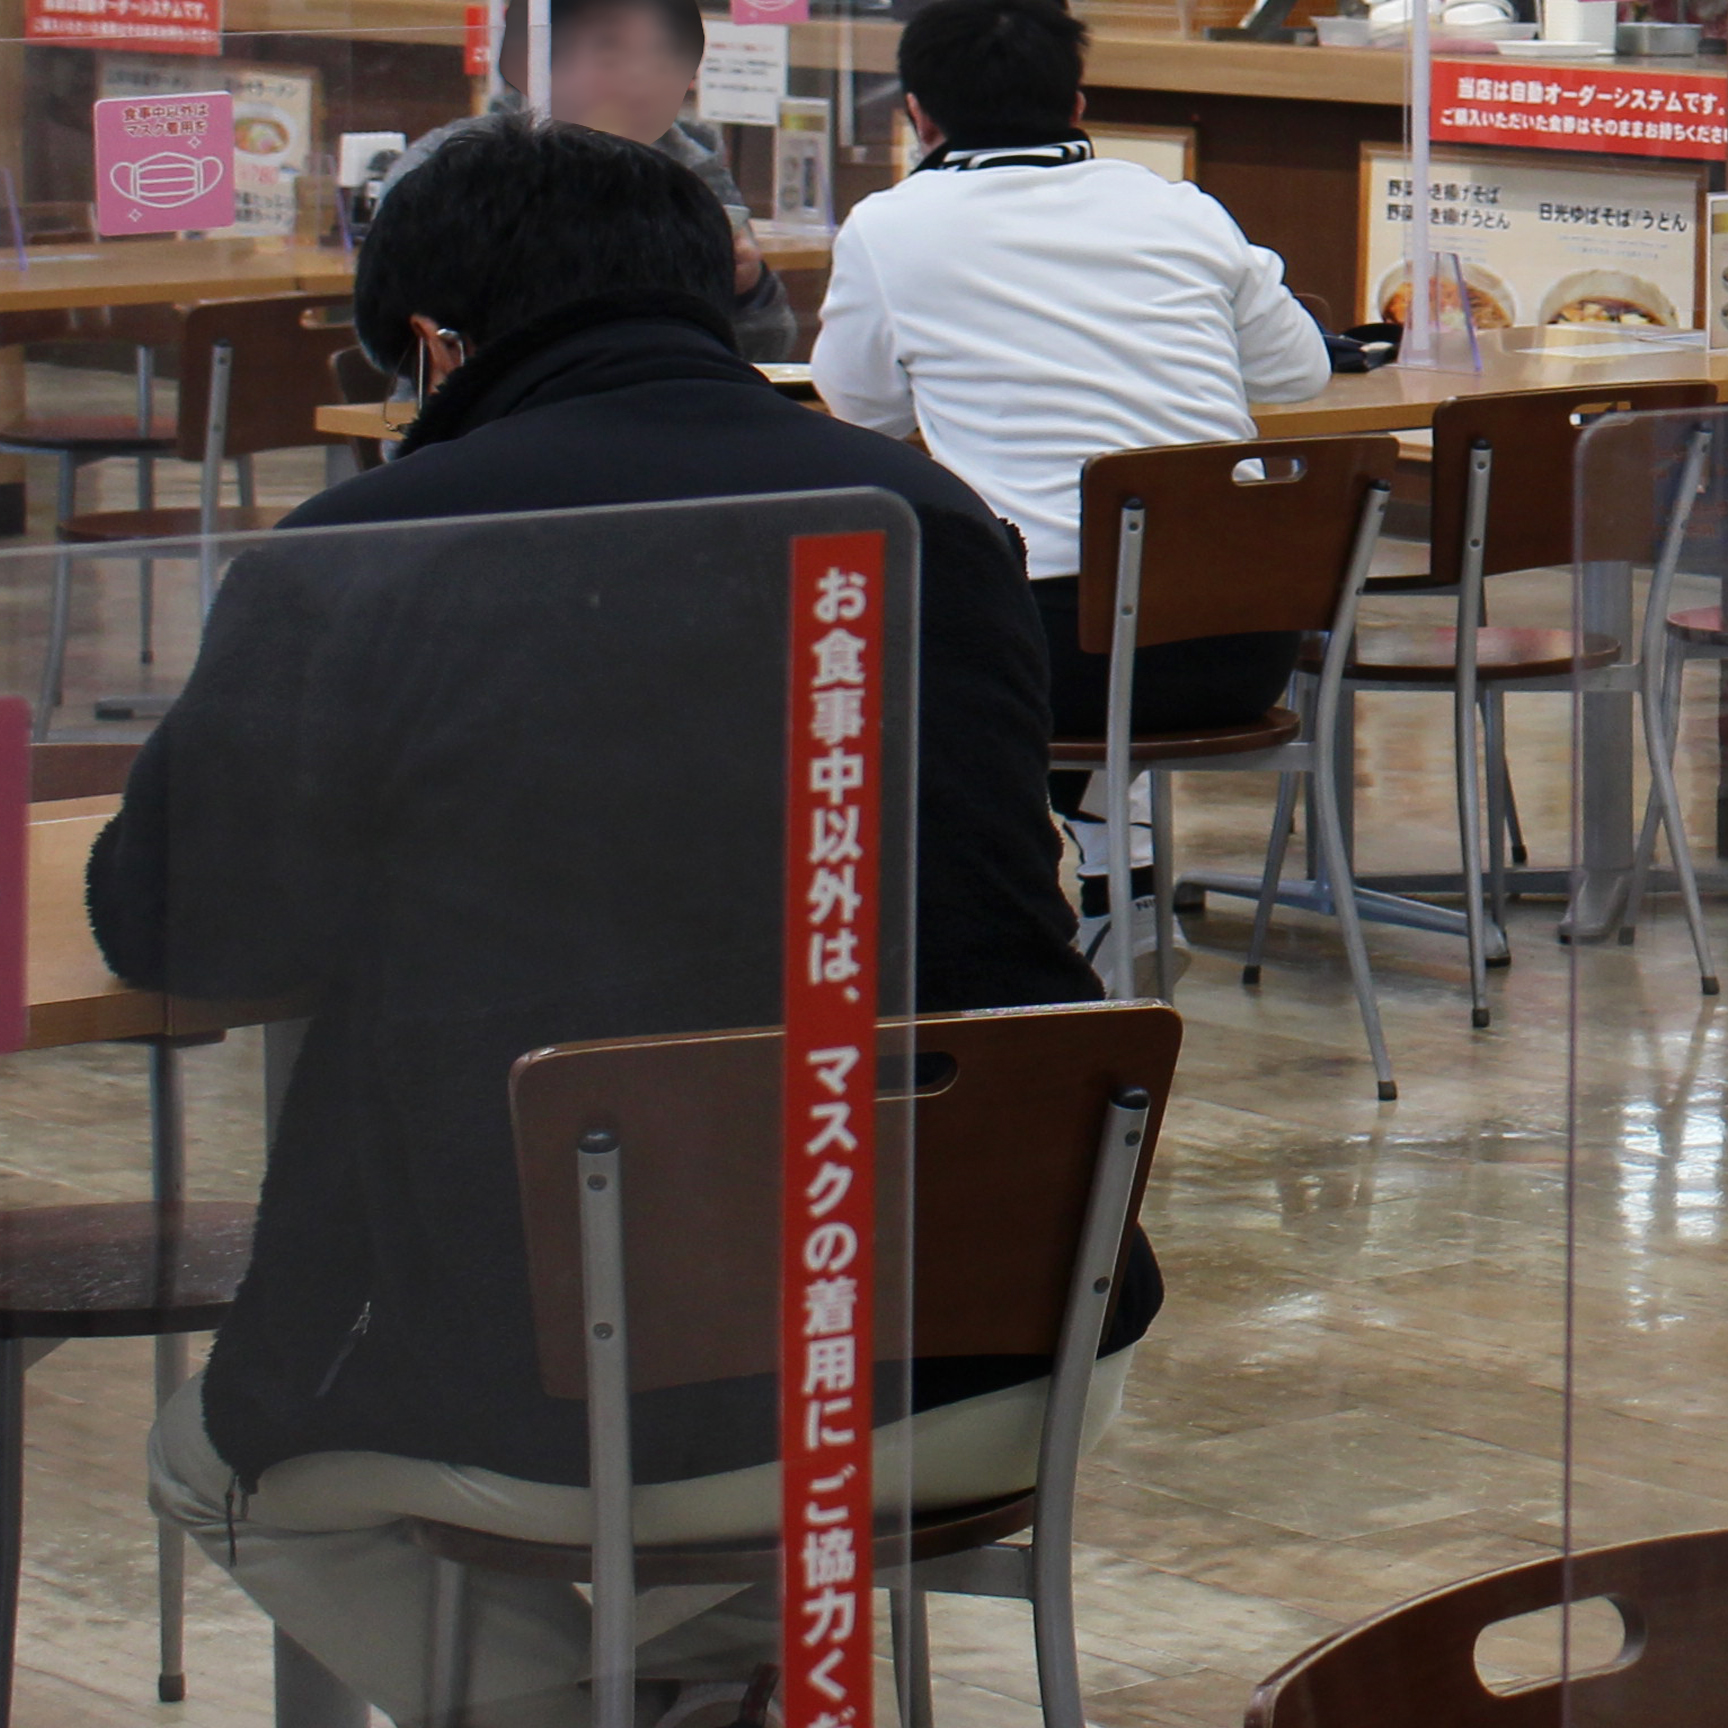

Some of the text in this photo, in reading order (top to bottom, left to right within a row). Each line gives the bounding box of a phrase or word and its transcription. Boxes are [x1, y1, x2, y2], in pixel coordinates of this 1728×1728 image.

[1457, 76, 1727, 116] 当店は自動オーダーシステムです。
[123, 103, 209, 122] 食事中以外は
[126, 121, 208, 139] マスク着用を
[1538, 201, 1688, 233] 日光ゆばそば/うどん
